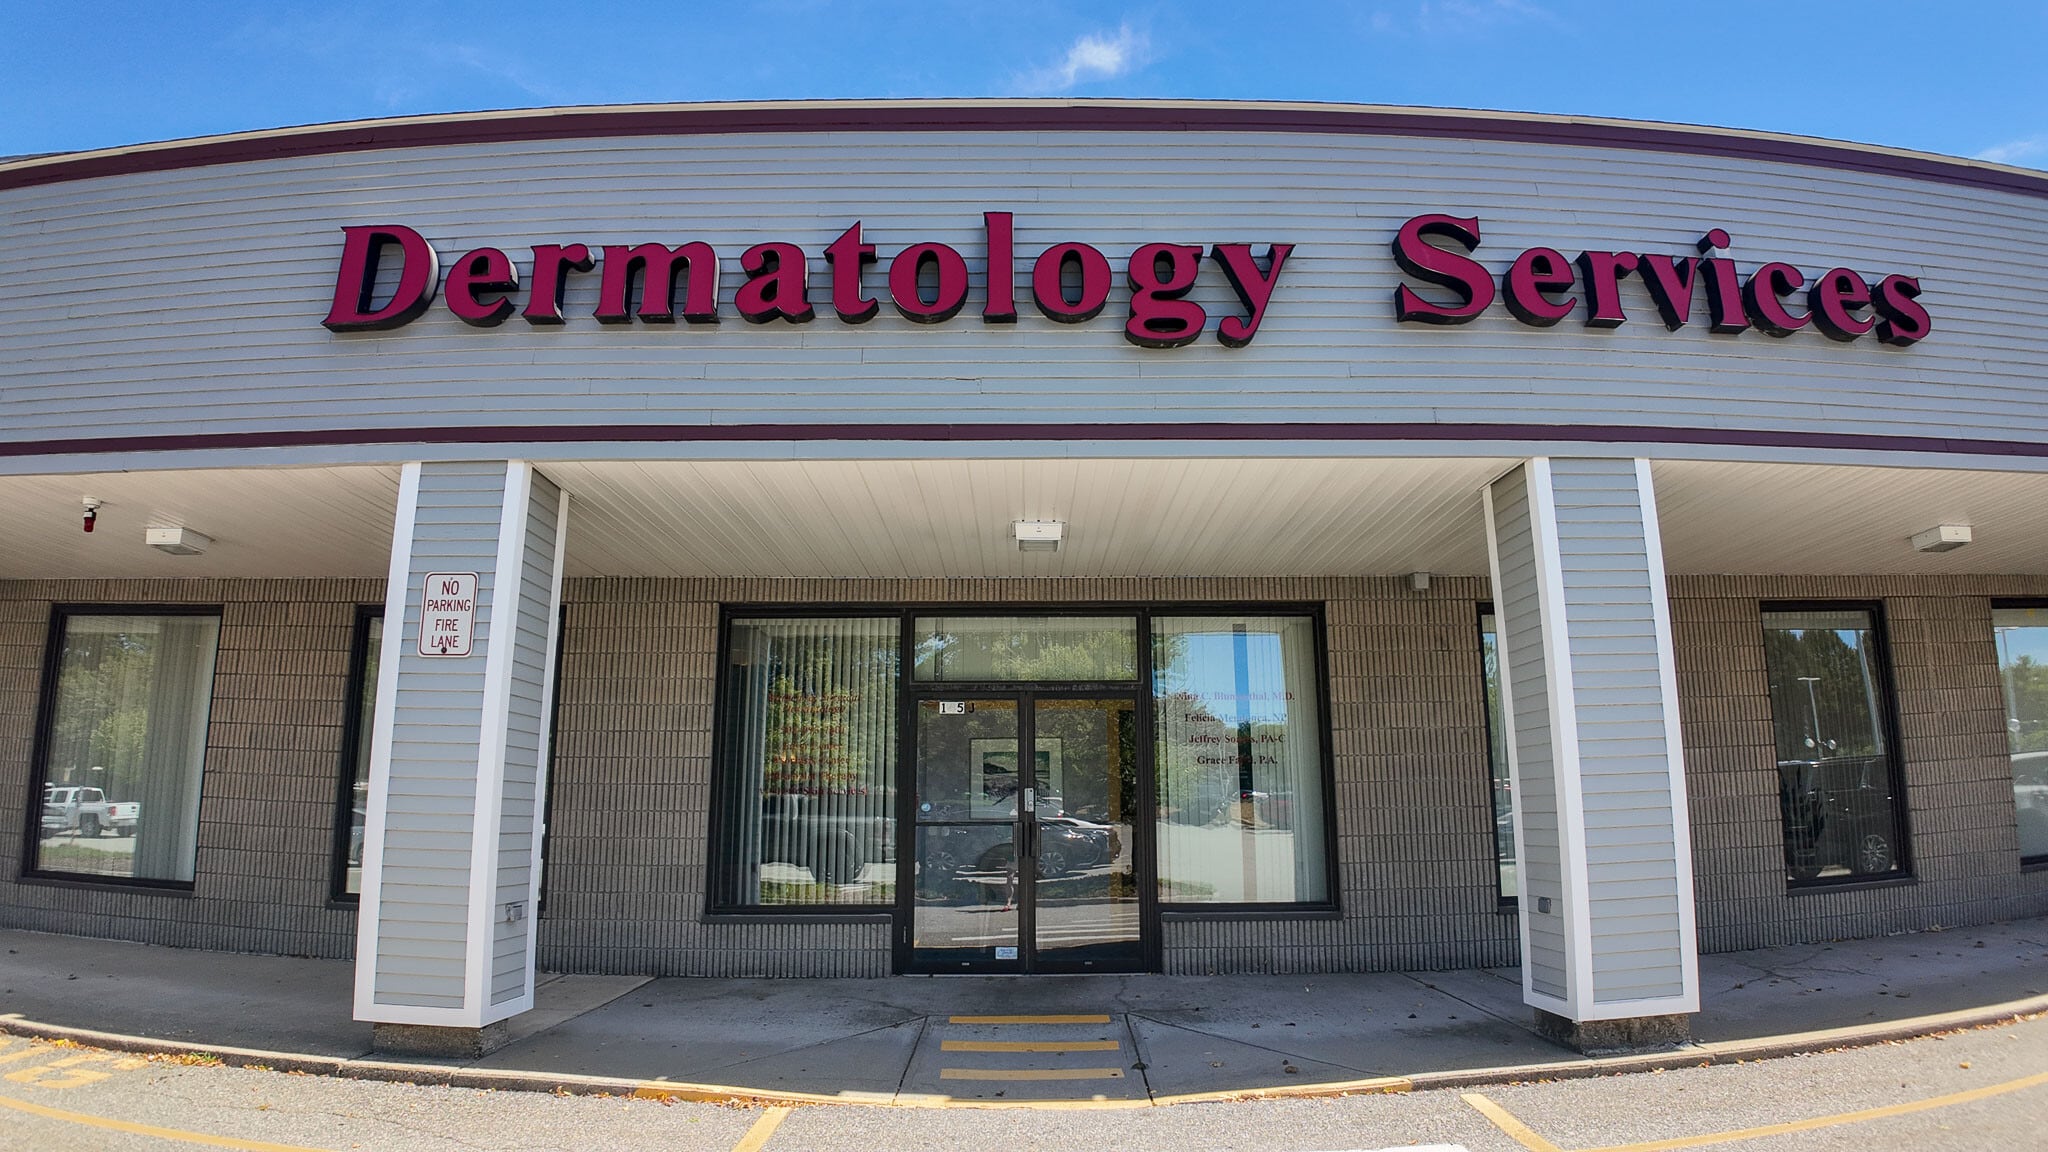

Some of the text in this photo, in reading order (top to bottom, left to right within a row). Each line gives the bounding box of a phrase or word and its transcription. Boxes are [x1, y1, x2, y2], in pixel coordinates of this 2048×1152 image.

[322, 211, 1931, 348] Dermatology Services
[441, 580, 460, 596] NO
[426, 599, 471, 612] PARKING
[434, 618, 459, 632] FIRE
[430, 635, 460, 648] LANE
[1188, 734, 1221, 746] Jeffrey
[1261, 734, 1286, 744] PA-C
[1197, 755, 1226, 765] Grace
